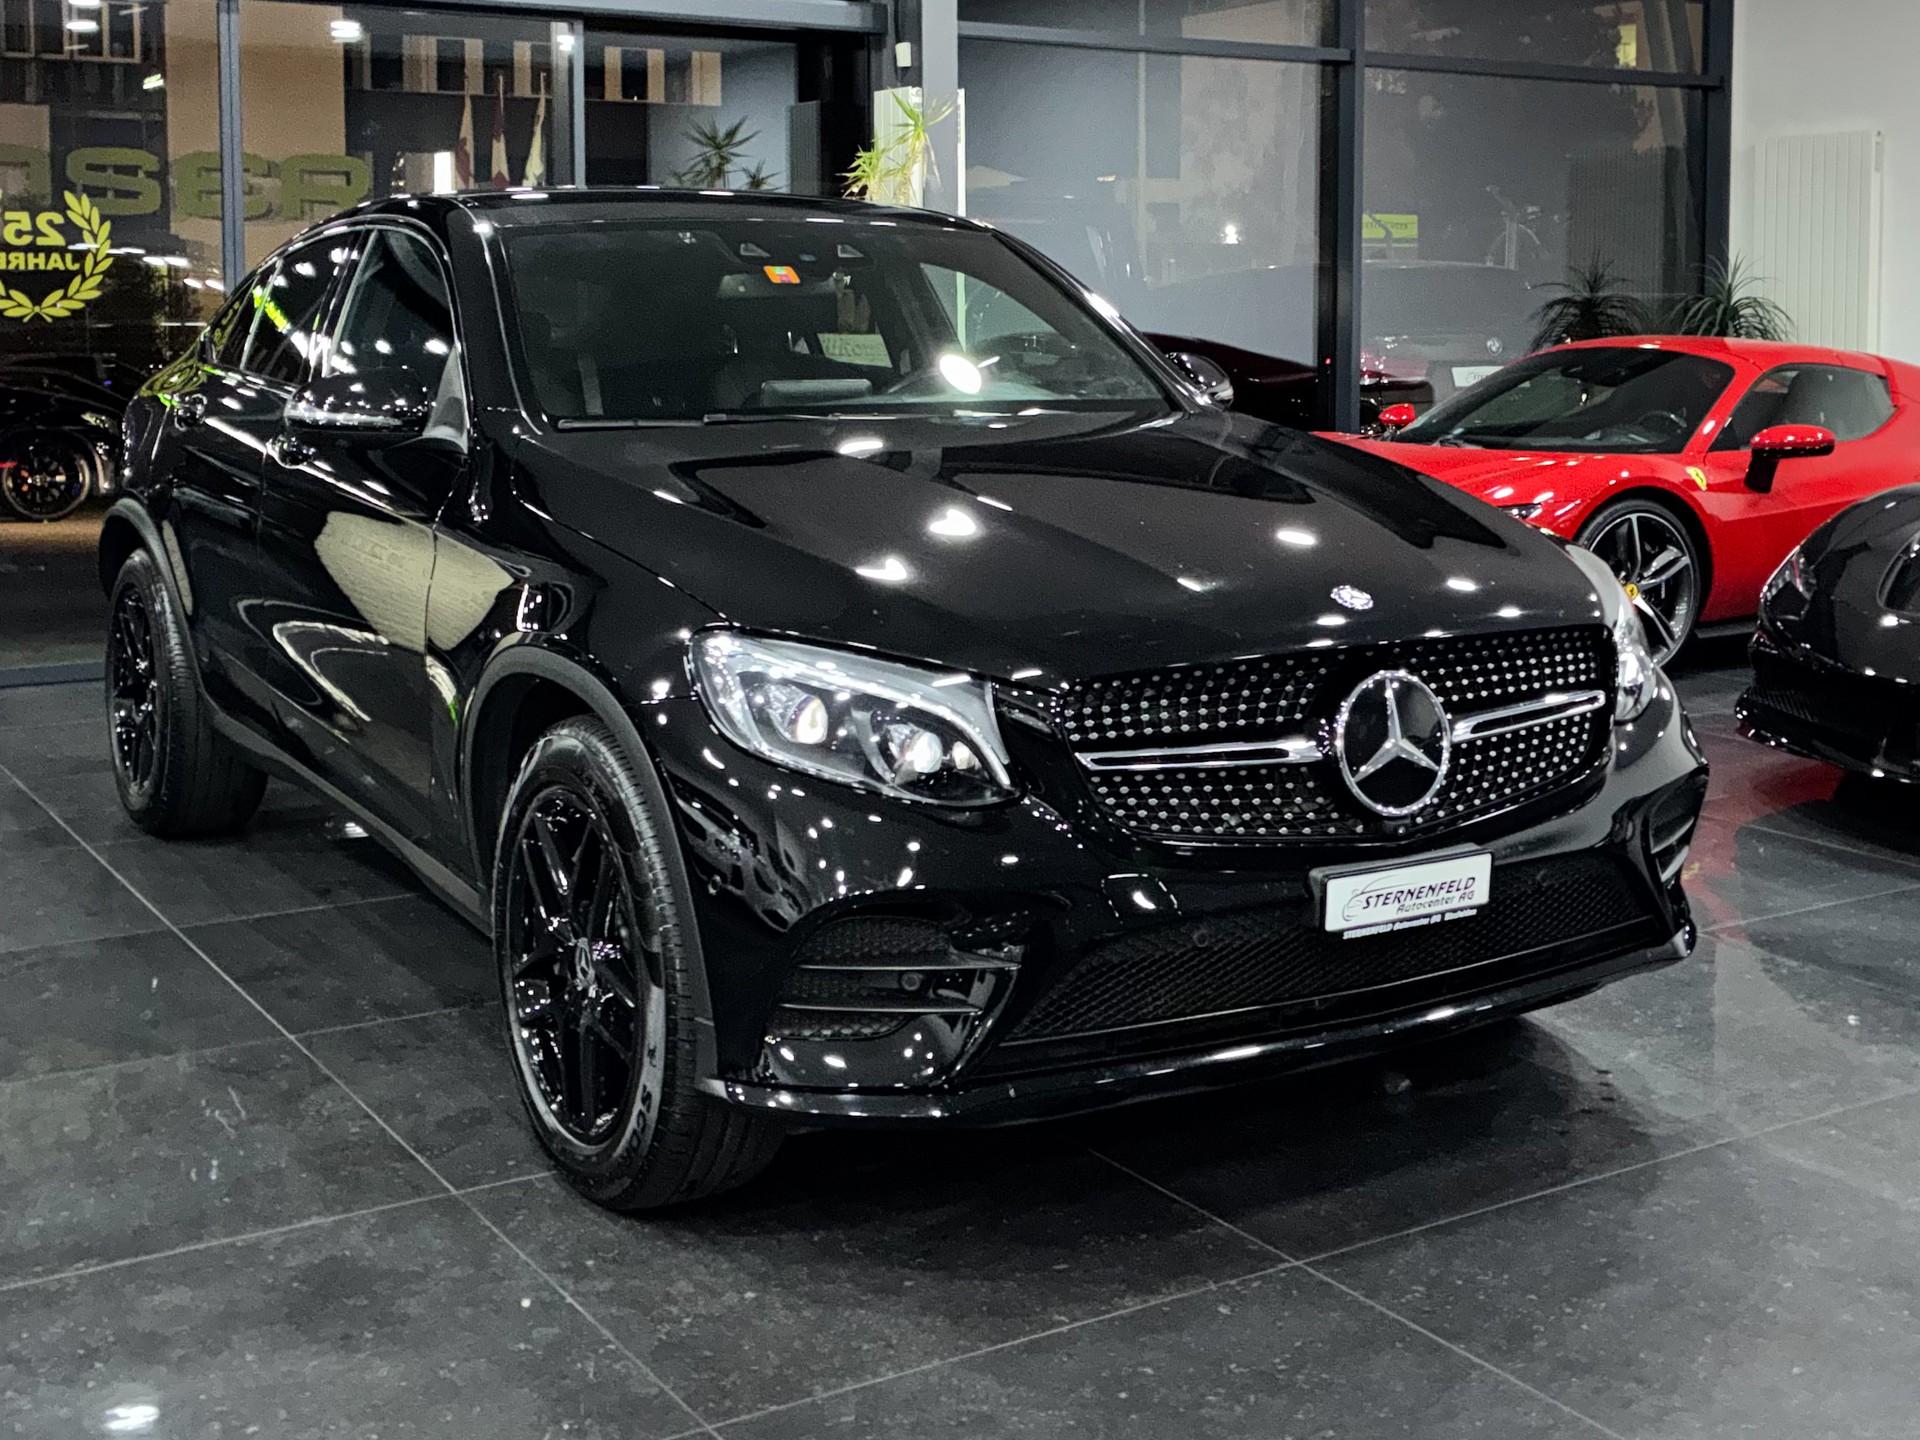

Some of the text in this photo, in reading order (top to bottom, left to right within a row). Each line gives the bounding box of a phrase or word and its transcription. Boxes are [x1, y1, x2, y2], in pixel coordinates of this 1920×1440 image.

[1363, 876, 1476, 910] STERNENFELD
[1396, 890, 1475, 915] Autocenter AG
